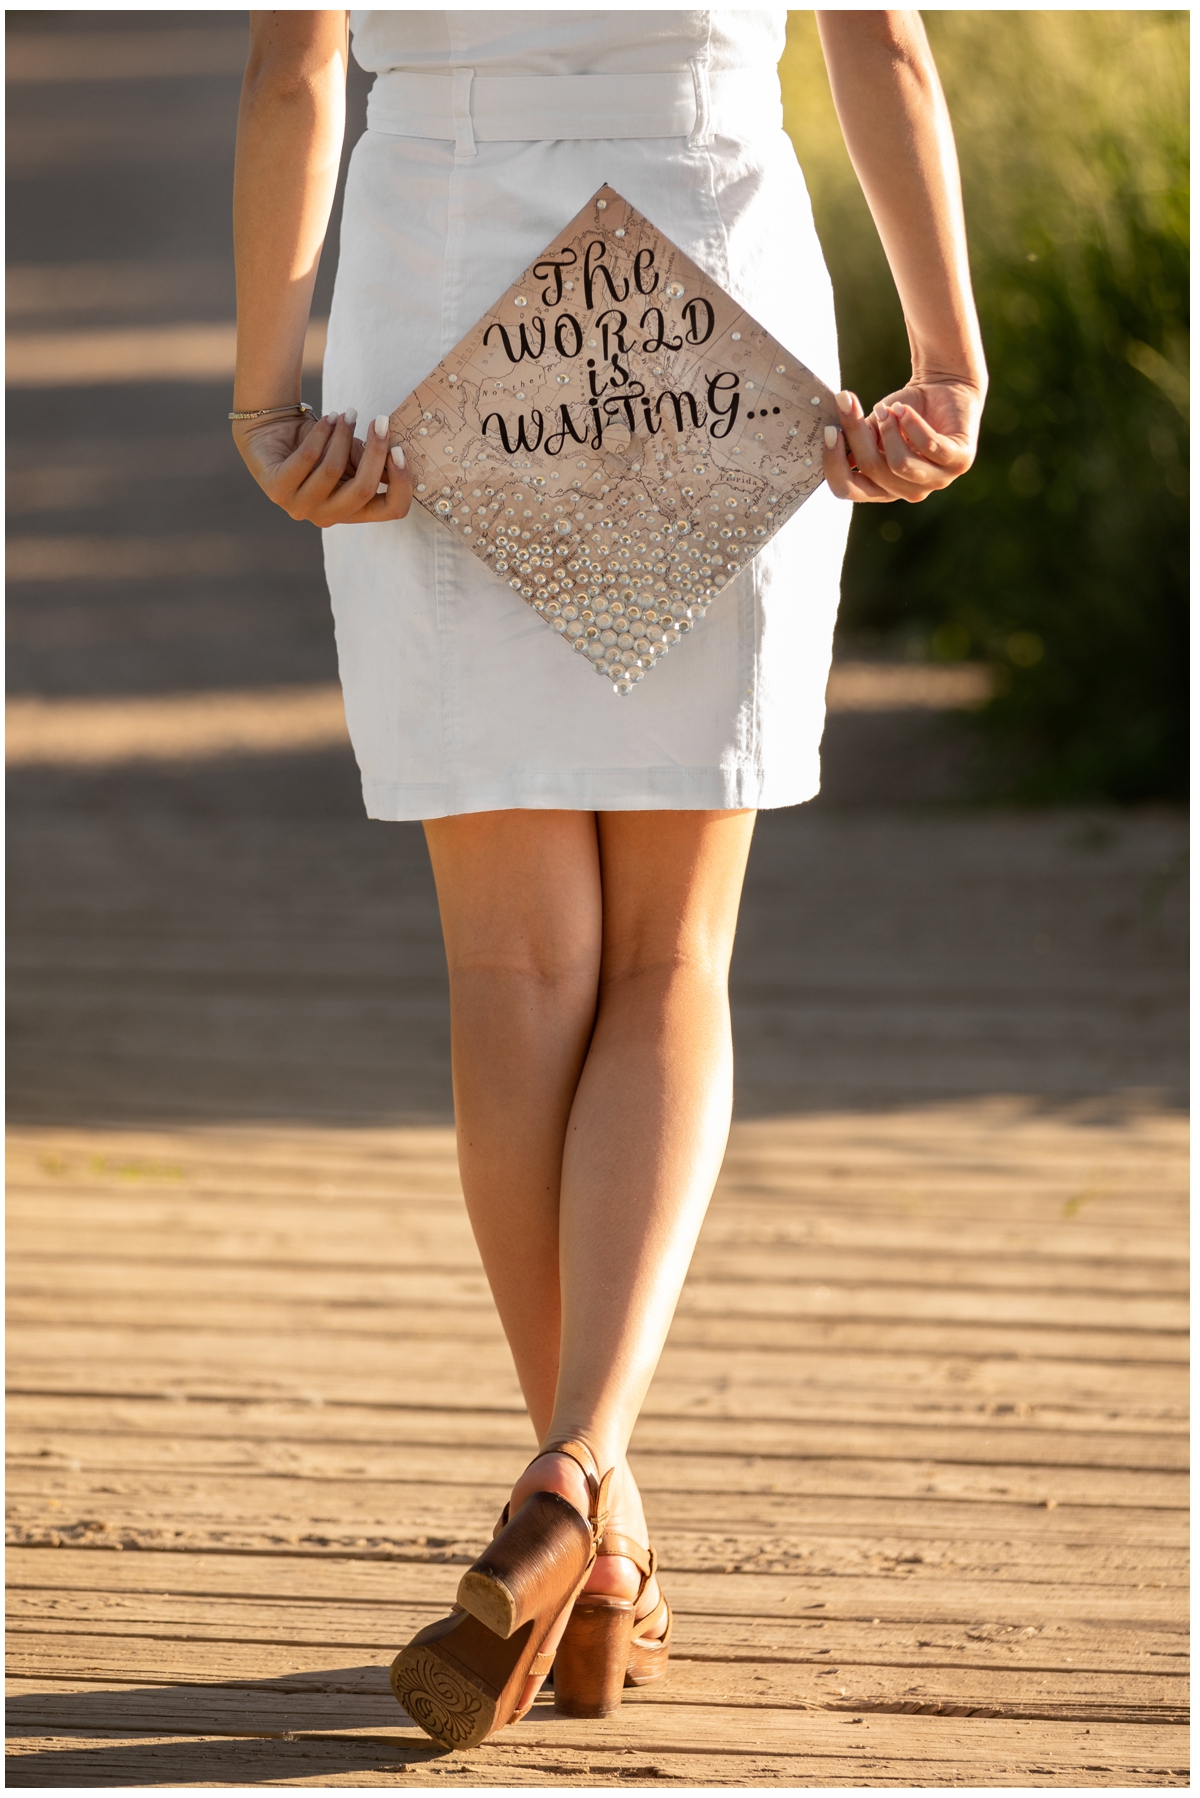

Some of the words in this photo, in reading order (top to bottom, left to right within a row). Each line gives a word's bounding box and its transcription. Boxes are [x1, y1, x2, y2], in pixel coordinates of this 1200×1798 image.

[532, 240, 659, 310] The
[482, 297, 715, 363] WORLD
[587, 352, 630, 398] is
[803, 415, 822, 448] Islands
